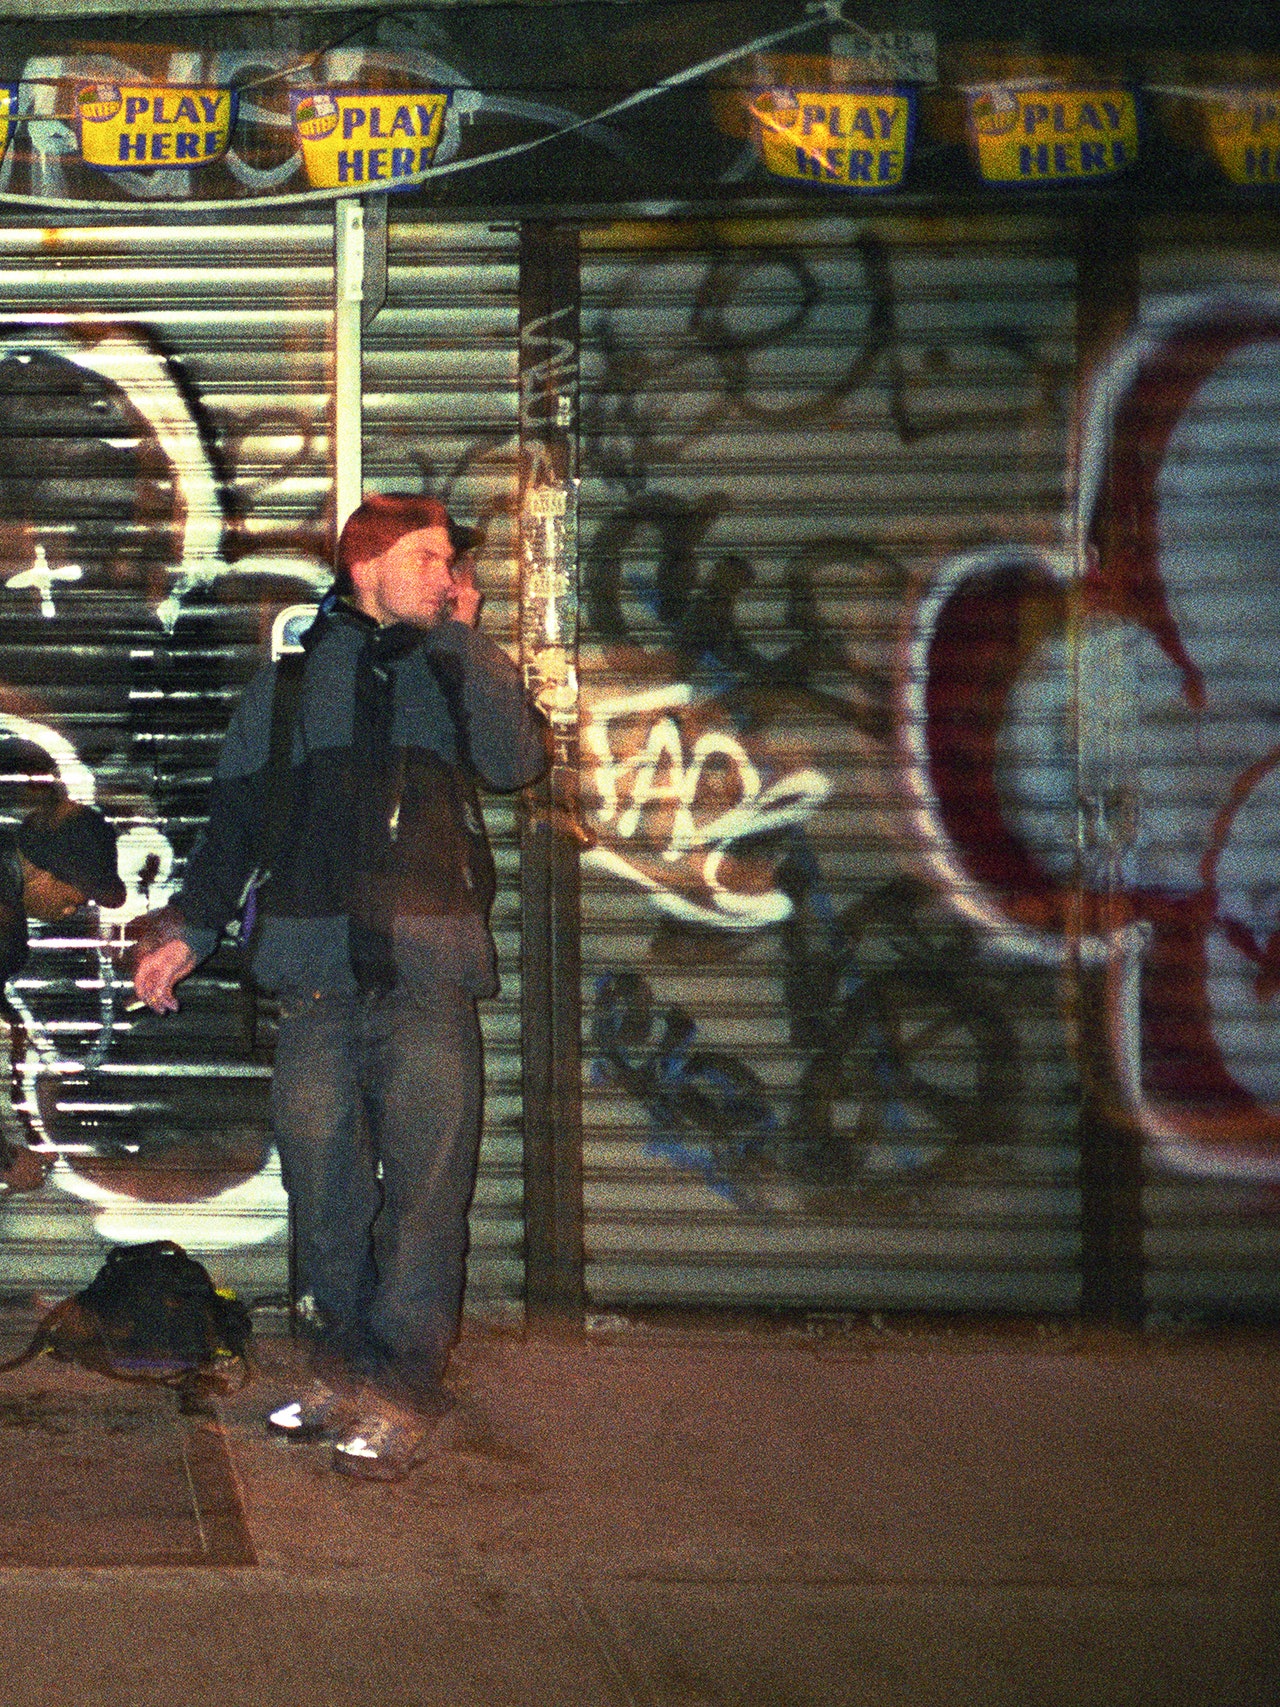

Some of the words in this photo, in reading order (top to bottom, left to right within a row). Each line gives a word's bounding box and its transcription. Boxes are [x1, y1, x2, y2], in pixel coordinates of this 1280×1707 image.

[125, 96, 223, 124] PLAY
[343, 105, 438, 139] PLAY
[803, 105, 899, 139] PLAY
[1025, 102, 1124, 134] PLAY
[119, 130, 224, 160] HERE
[796, 147, 900, 181] HERE
